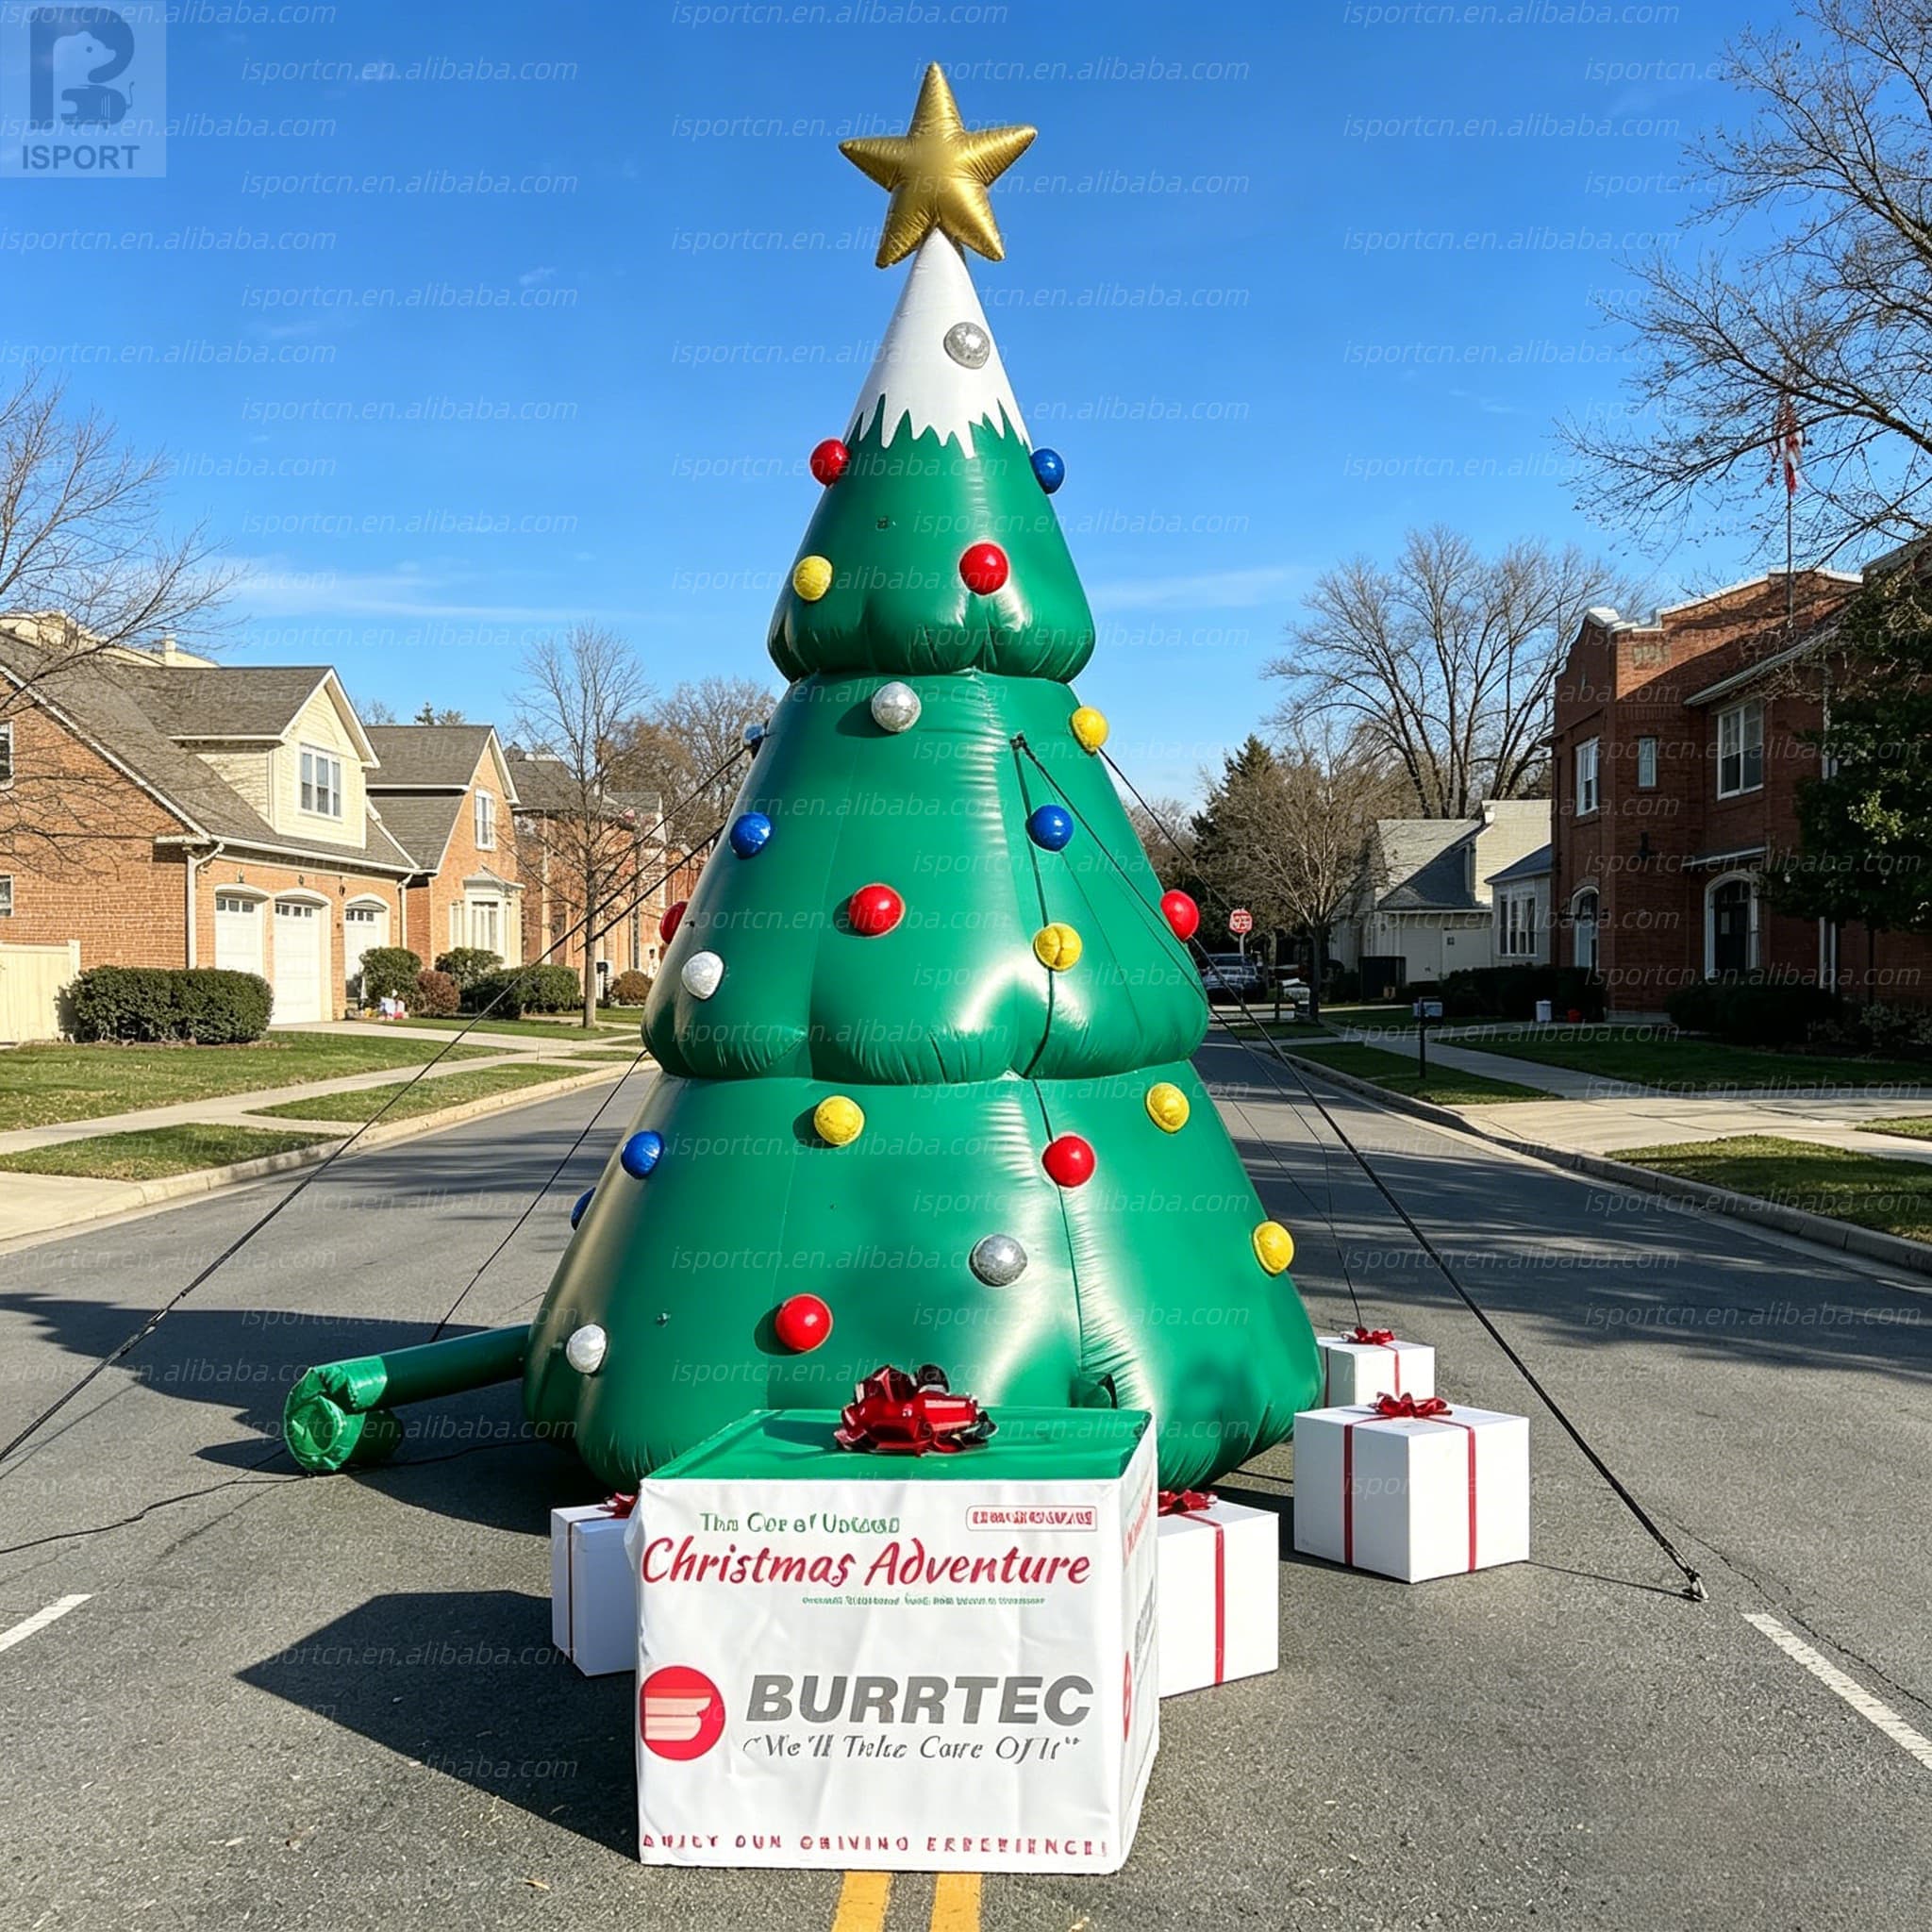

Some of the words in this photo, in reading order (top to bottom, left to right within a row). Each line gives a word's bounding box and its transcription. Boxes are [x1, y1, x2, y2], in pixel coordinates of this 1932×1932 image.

[641, 1535, 856, 1588] Christmas
[863, 1537, 1091, 1586] Adventure
[745, 1674, 1094, 1726] BURRTEC
